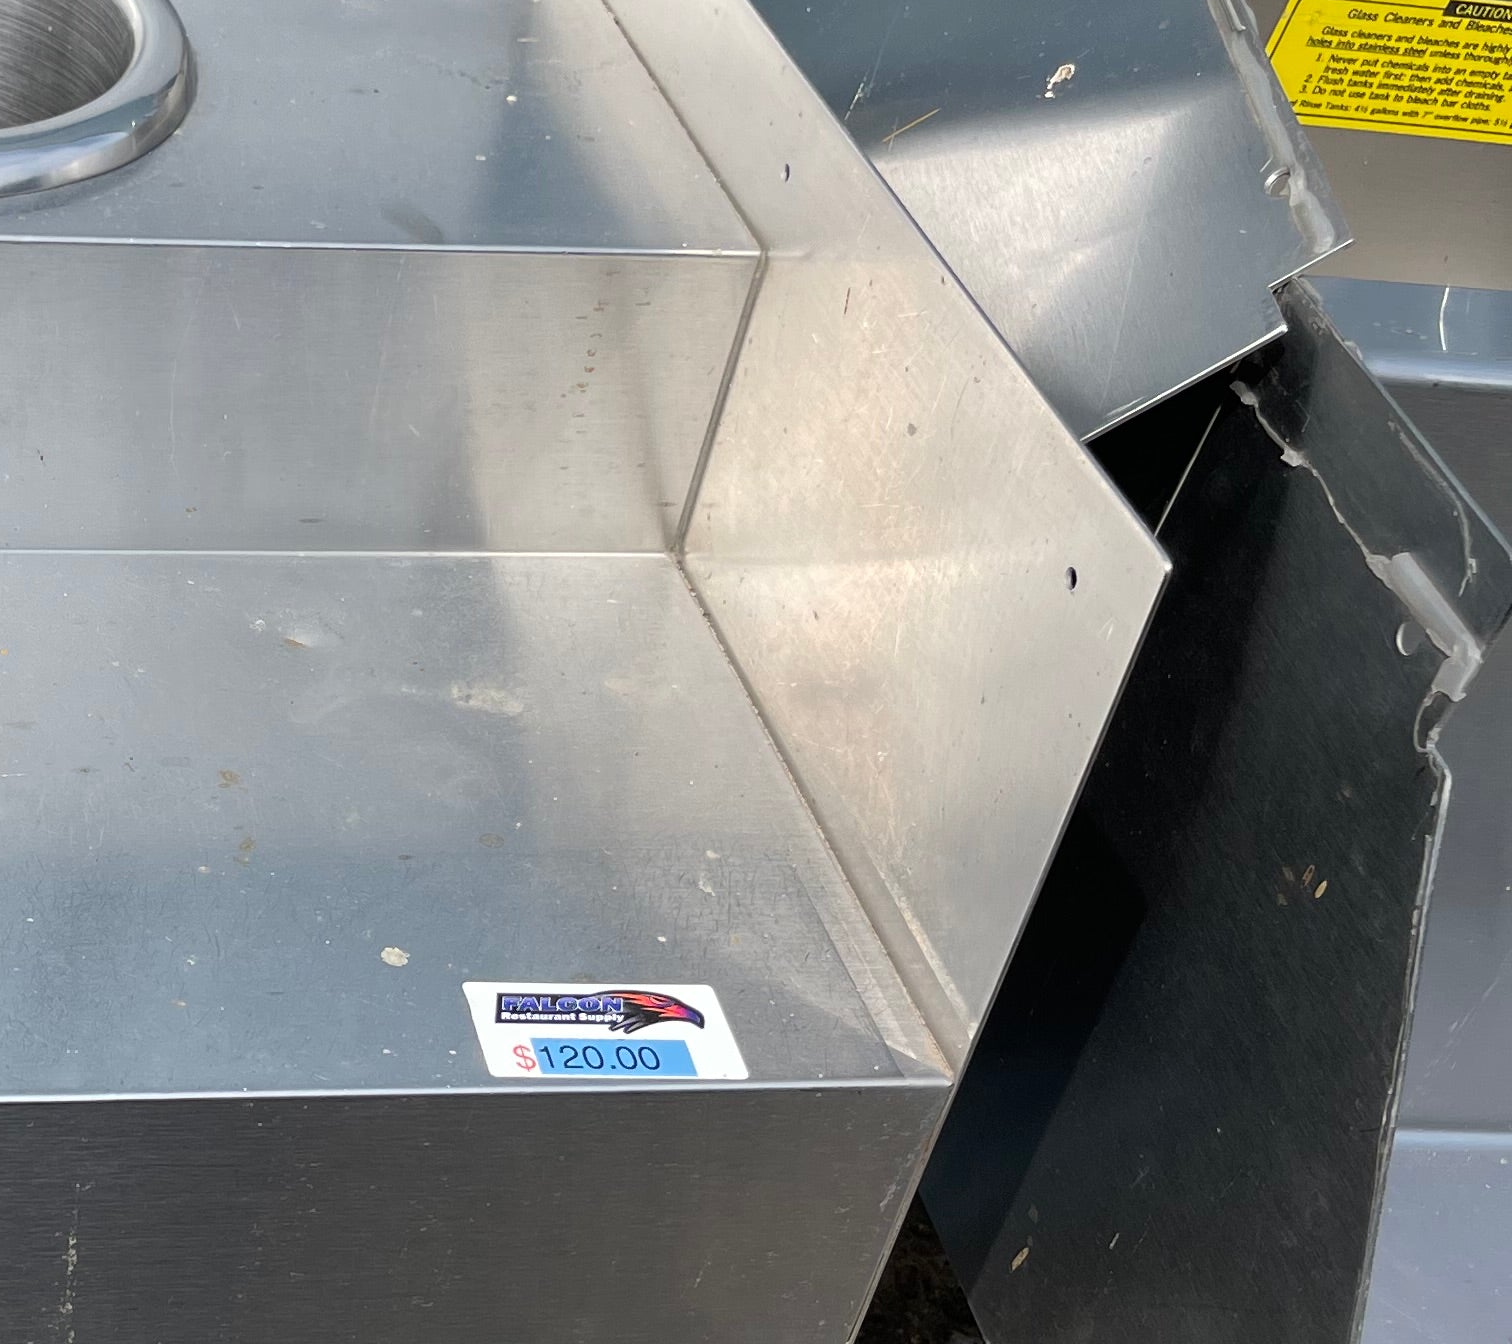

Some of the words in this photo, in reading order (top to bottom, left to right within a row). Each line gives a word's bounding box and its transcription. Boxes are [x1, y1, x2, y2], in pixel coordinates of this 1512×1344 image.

[1348, 8, 1379, 22] Glass
[1384, 11, 1434, 27] Cleaners
[1438, 18, 1463, 30] and
[1306, 36, 1333, 48] holes
[1334, 39, 1356, 50] into
[1357, 42, 1401, 55] stainless
[1402, 47, 1429, 57] steel
[1429, 49, 1460, 59] unless
[1322, 25, 1348, 37] Glass
[1350, 29, 1393, 42] cleaners
[1394, 34, 1416, 43] and
[1417, 35, 1460, 49] bleaches
[1462, 42, 1479, 50] are
[1323, 65, 1348, 75] fresh
[1352, 69, 1380, 78] water
[1409, 73, 1432, 83] then
[1434, 77, 1455, 86] add
[1328, 54, 1358, 65] Never
[1360, 58, 1380, 68] put
[1381, 60, 1430, 72] chemicals
[1432, 63, 1452, 74] into
[1454, 68, 1467, 76] an
[1469, 70, 1501, 81] empty
[1312, 85, 1327, 95] Do
[1329, 88, 1347, 97] not
[1348, 91, 1366, 99] use
[1369, 91, 1390, 101] tank
[1393, 93, 1404, 103] to
[1406, 94, 1439, 106] bleach
[1441, 98, 1459, 107] bar
[1317, 75, 1344, 86] Flush
[1347, 78, 1375, 88] tanks
[1376, 80, 1437, 96] immediately
[1437, 87, 1462, 97] after
[502, 996, 624, 1013] FALCON
[501, 1012, 577, 1020] Restaurant
[579, 1013, 625, 1022] Supply
